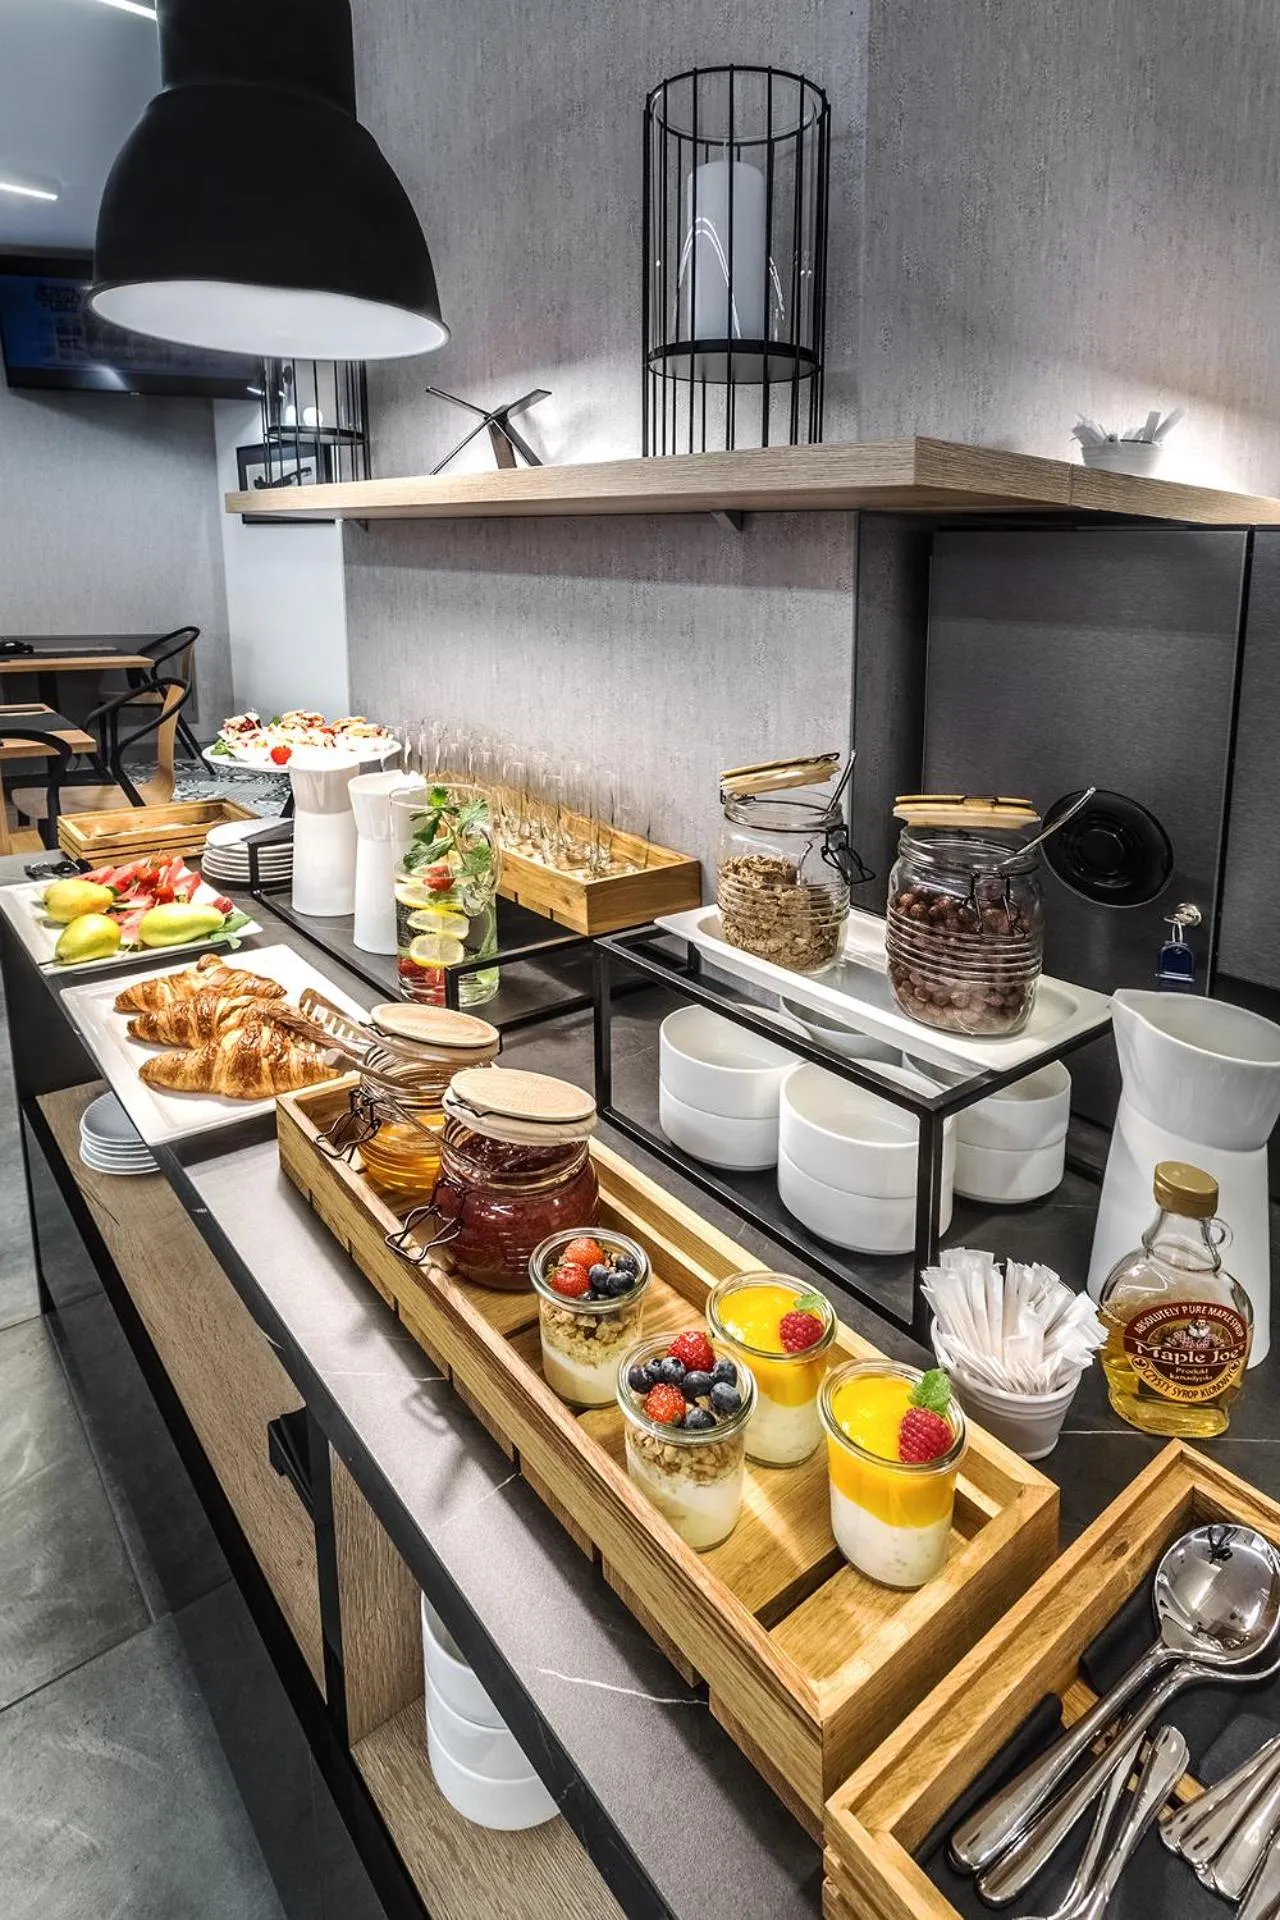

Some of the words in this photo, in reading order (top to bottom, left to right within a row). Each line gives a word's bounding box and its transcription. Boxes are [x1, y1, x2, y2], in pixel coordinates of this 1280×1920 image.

[1134, 1306, 1180, 1334] ABSOLUTELY
[1182, 1305, 1207, 1314] PURE
[1208, 1306, 1234, 1323] MAPLE
[1135, 1340, 1206, 1364] Maple
[1212, 1350, 1239, 1363] Joe
[1142, 1369, 1171, 1392] CZYSTY
[1172, 1388, 1199, 1399] SYROP
